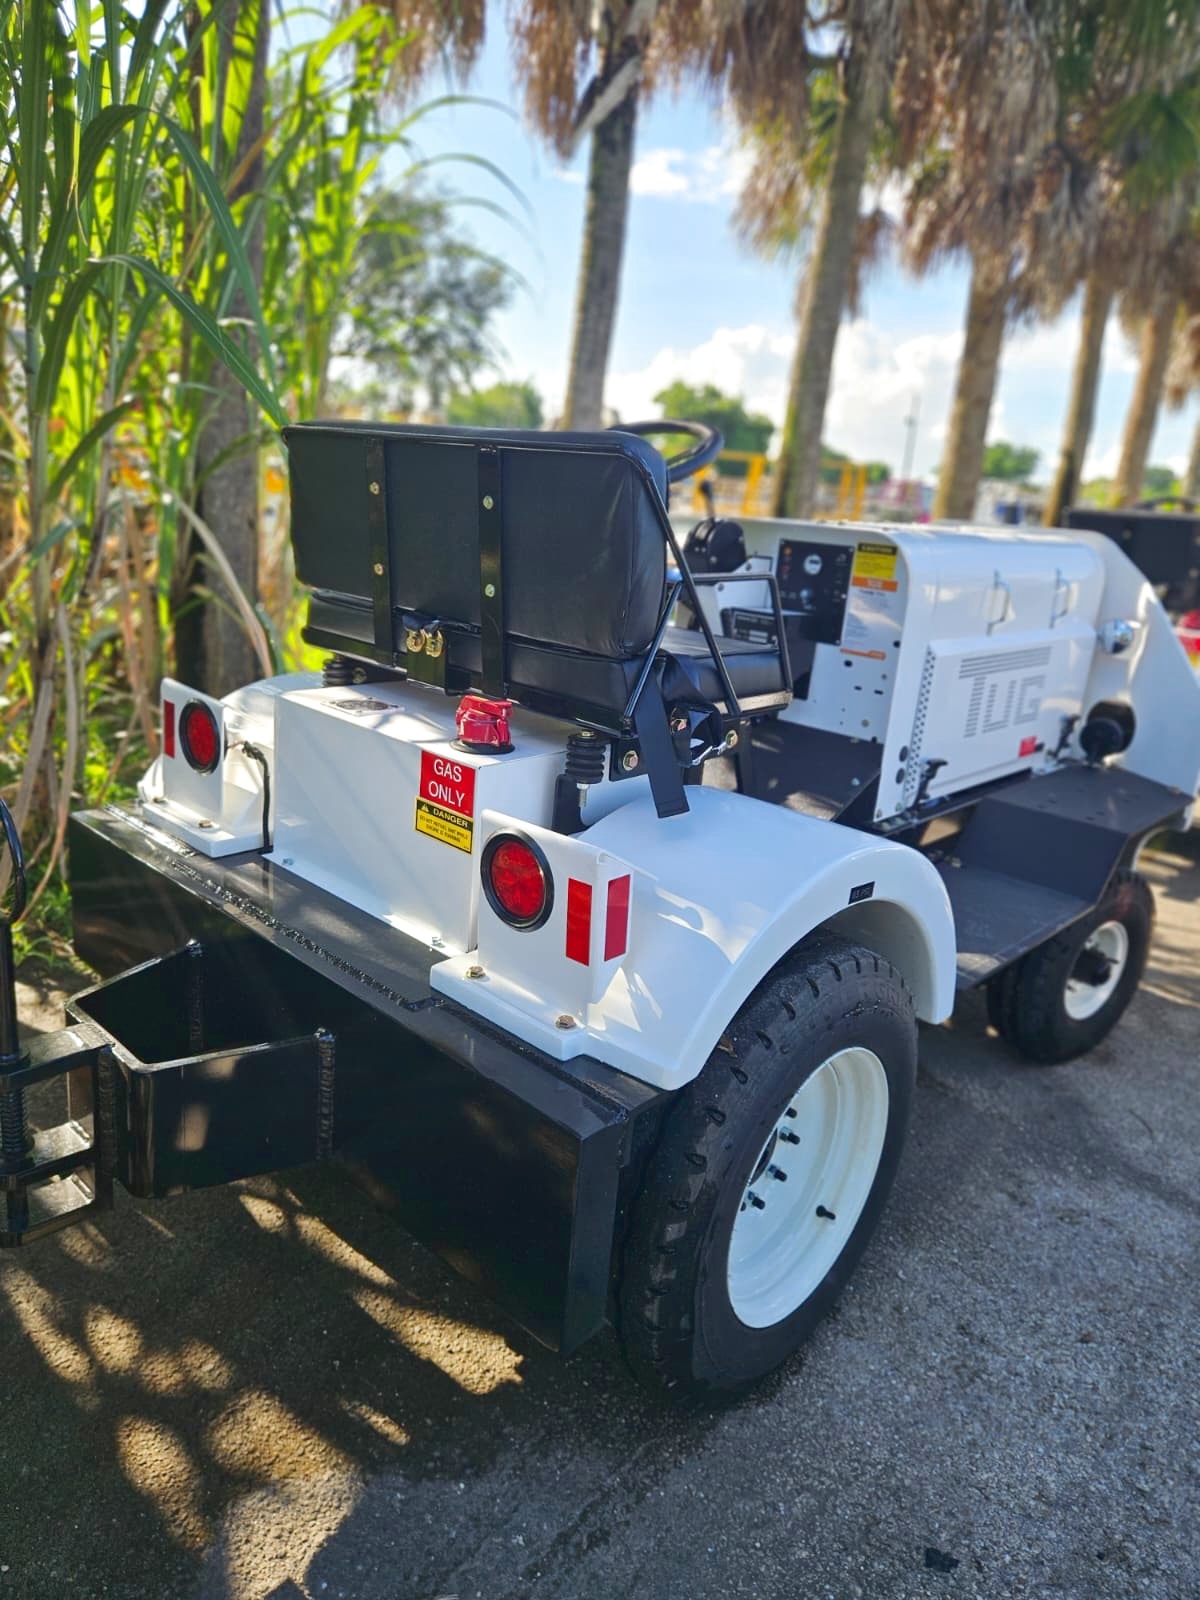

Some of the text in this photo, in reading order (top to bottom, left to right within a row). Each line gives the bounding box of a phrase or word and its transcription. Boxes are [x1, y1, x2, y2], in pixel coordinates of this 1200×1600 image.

[958, 646, 1053, 738] TUG
[433, 759, 462, 783] GAS
[428, 780, 465, 808] ONLY
[433, 808, 468, 828] DANGER
